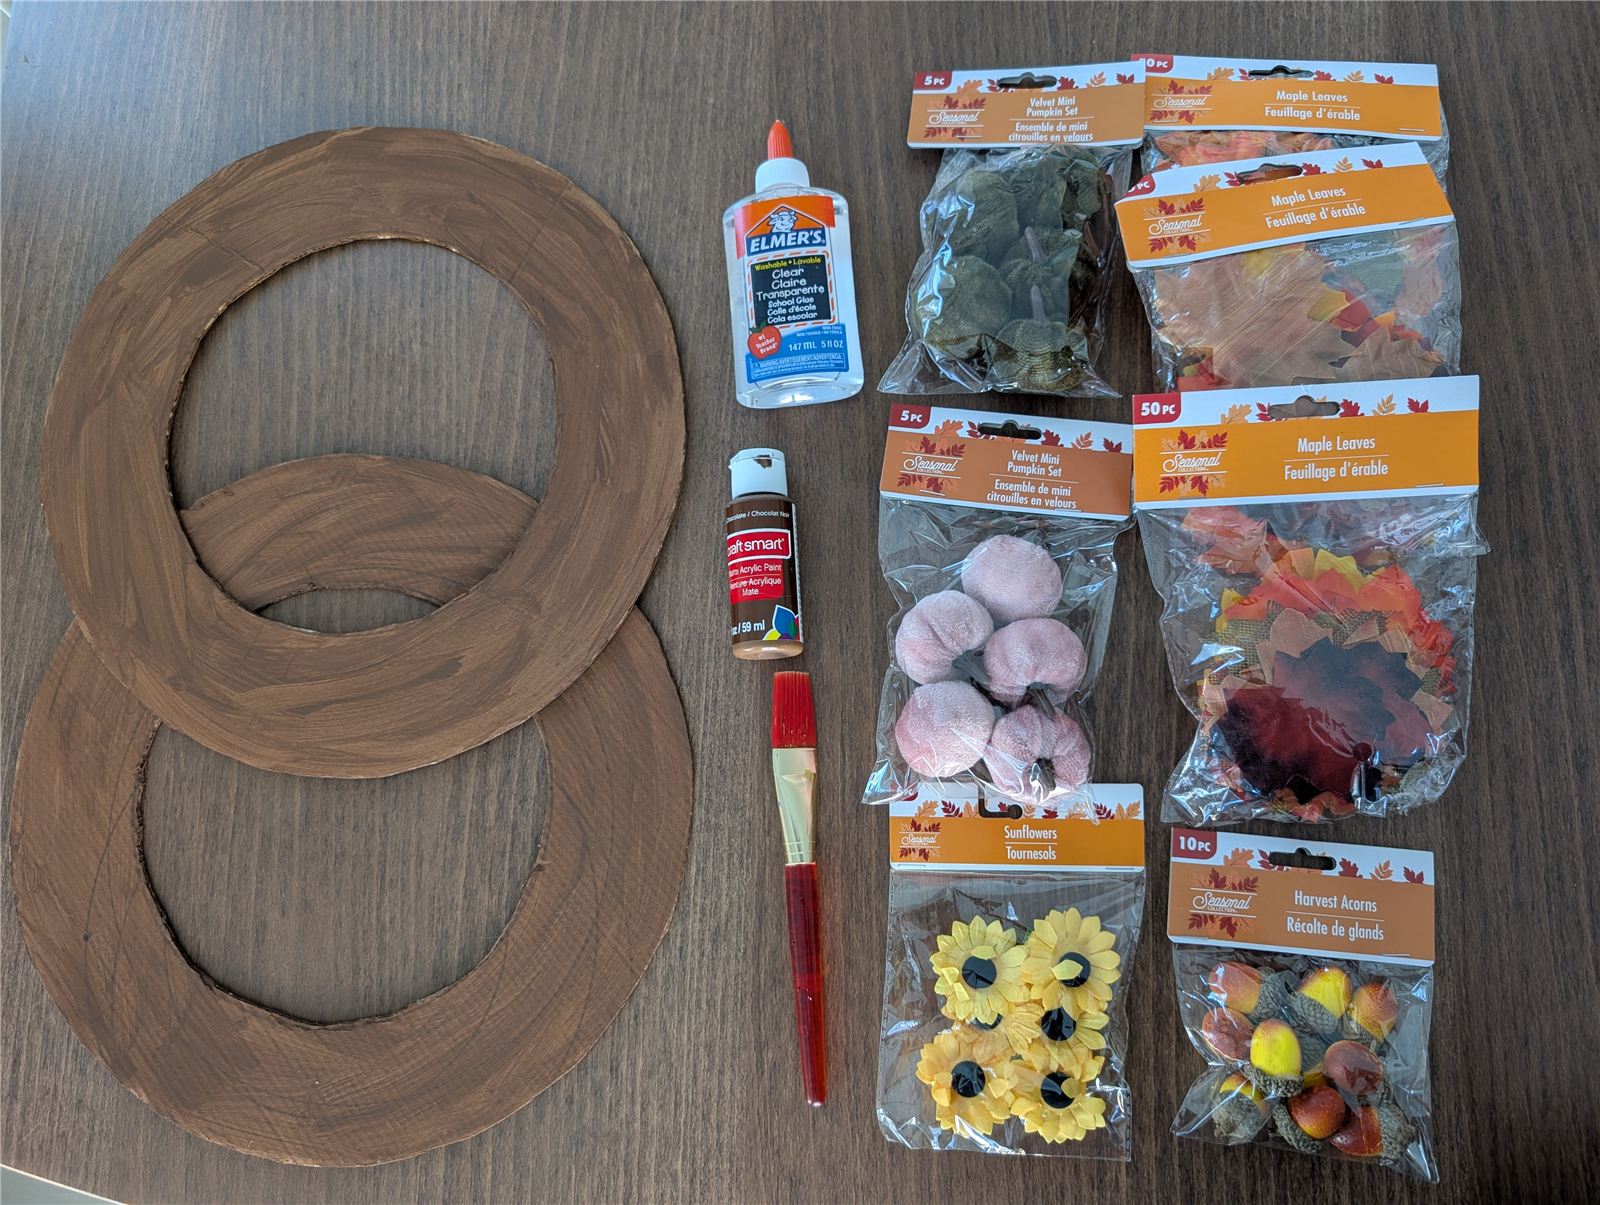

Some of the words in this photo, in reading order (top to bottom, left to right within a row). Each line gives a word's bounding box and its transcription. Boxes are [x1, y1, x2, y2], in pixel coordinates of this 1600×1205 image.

[1030, 97, 1056, 108] Velvet
[1058, 96, 1075, 106] Mini
[1153, 95, 1207, 108] Seasonal
[1276, 90, 1309, 102] Maple
[1312, 91, 1348, 103] Leaves
[928, 111, 980, 125] Seasonal
[1026, 107, 1063, 119] Pumpkin
[1065, 107, 1079, 116] Set
[1264, 107, 1313, 120] Feuillage
[1316, 107, 1361, 121] d'érable
[1015, 122, 1054, 132] Ensemble
[1056, 122, 1067, 131] de
[1069, 121, 1088, 131] mini
[1008, 132, 1048, 142] citrouilles
[1050, 134, 1061, 142] en
[1064, 132, 1094, 143] velours
[1271, 192, 1306, 208] Maple
[1308, 186, 1346, 201] Leaves
[1265, 209, 1318, 229] Feuillage
[1319, 203, 1366, 221] d'érable
[1148, 214, 1202, 236] Seasonal
[750, 230, 822, 253] ELMER'S
[755, 261, 788, 271] Washable
[793, 256, 822, 265] Lavable
[772, 267, 805, 279] Clear
[771, 278, 807, 290] Claire
[756, 284, 825, 301] Transparente
[768, 297, 795, 309] School
[796, 296, 815, 304] Glue
[767, 307, 787, 316] Colle
[788, 304, 817, 313] d'école
[767, 315, 787, 324] Cola
[787, 312, 818, 322] escolar
[789, 343, 801, 351] 147
[1141, 401, 1161, 416] 50
[1162, 404, 1176, 415] PC
[1297, 437, 1333, 454] Maple
[1336, 436, 1376, 451] Leaves
[903, 455, 958, 472] Seasonal
[1011, 450, 1038, 463] Velvet
[1040, 452, 1060, 465] Mini
[1163, 452, 1222, 473] Seasonal
[1007, 461, 1046, 476] Pumpkin
[1048, 465, 1062, 477] Set
[1284, 464, 1338, 482] Feuillage
[1339, 461, 1389, 478] d'érable
[994, 479, 1036, 494] Ensemble
[1038, 483, 1049, 495] de
[1051, 485, 1071, 497] mini
[986, 491, 1029, 505] citrouilles
[1030, 496, 1042, 506] en
[1044, 495, 1077, 509] velours
[744, 538, 783, 552] smart
[740, 563, 762, 574] Acrylic
[764, 563, 782, 571] Paint
[748, 577, 782, 587] Acrylique
[742, 588, 759, 596] Mate
[742, 621, 752, 632] 59
[753, 619, 766, 632] ml
[1004, 825, 1058, 840] Sunflowers
[1006, 846, 1057, 860] Tournesols
[1192, 891, 1252, 910] Seasonal
[1294, 890, 1338, 909] Harvest
[1340, 895, 1377, 912] Acorns
[1286, 916, 1328, 935] Récolte
[1331, 920, 1345, 937] de
[1348, 922, 1384, 941] glands
